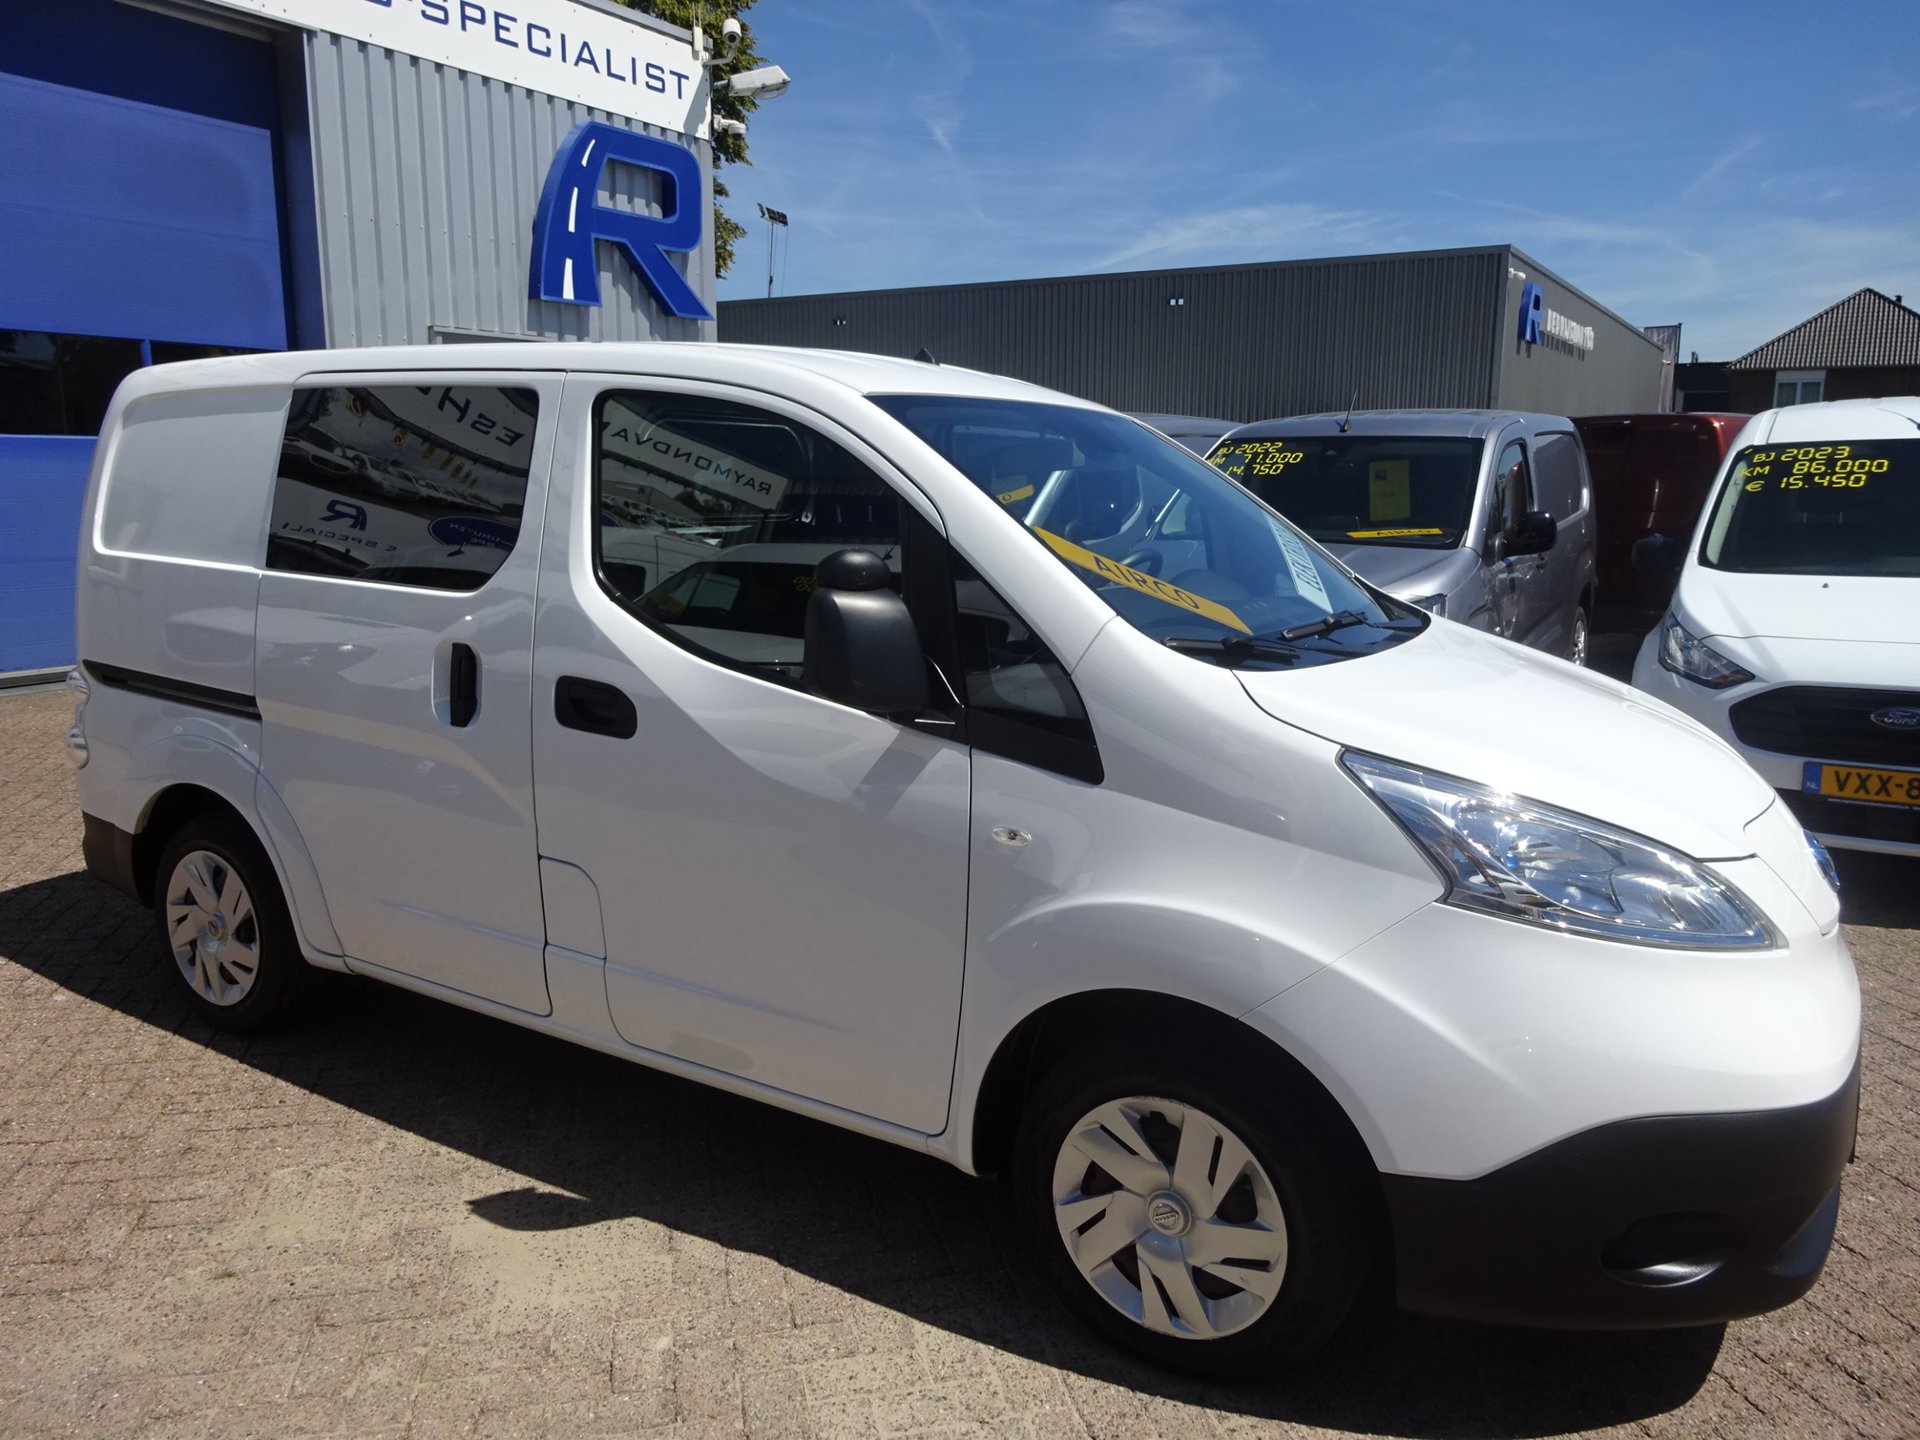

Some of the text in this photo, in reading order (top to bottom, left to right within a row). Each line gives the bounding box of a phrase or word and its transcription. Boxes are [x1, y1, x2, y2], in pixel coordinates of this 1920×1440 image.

[420, 0, 690, 100] SPECIALIST
[1235, 442, 1283, 454] 2022
[1753, 446, 1850, 463] BJ 2023
[1741, 459, 1889, 477] KM 86.000
[1780, 473, 1867, 488] 15.450
[1093, 556, 1200, 610] AIRCO
[1834, 770, 1920, 800] VXX-8
